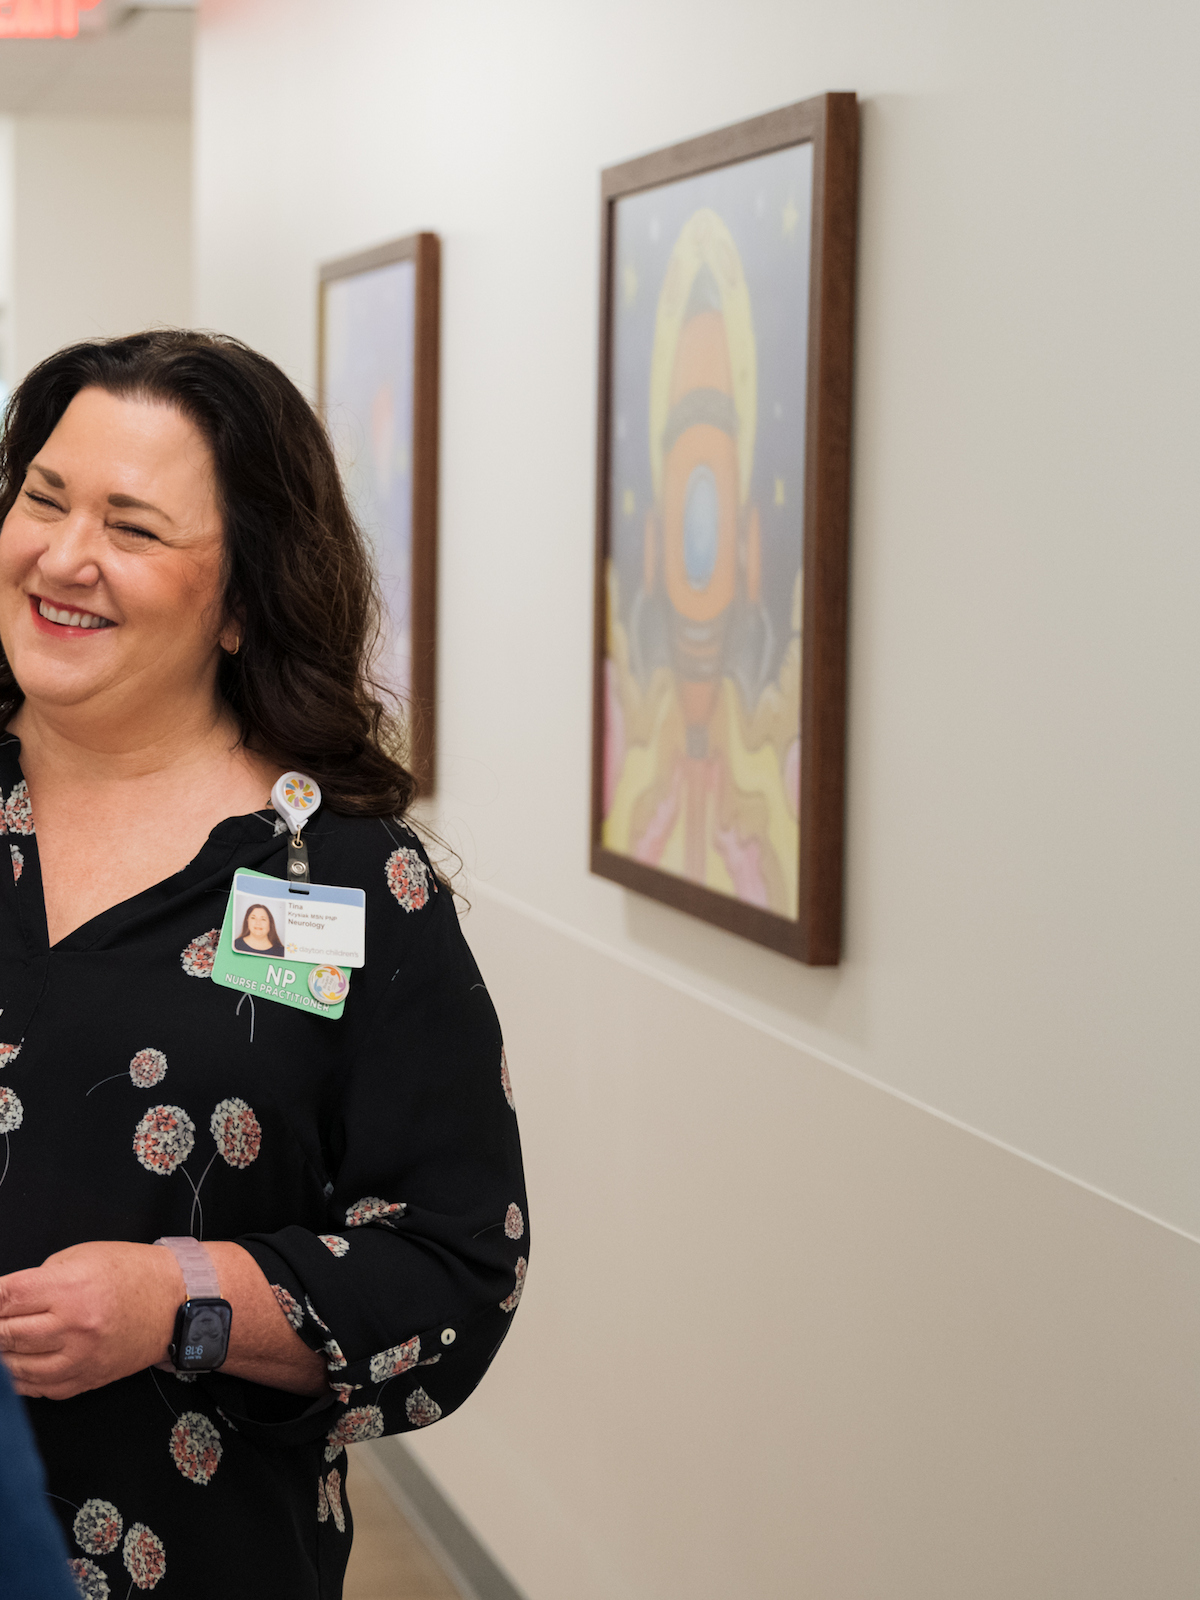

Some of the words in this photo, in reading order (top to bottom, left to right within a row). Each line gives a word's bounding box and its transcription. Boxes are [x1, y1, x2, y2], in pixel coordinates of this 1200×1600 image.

[288, 902, 304, 910] Tina
[288, 918, 326, 930] Neurology
[299, 946, 325, 955] dayton
[325, 949, 359, 958] children's
[265, 964, 296, 988] NP
[225, 973, 258, 990] NURSE
[259, 983, 330, 1012] PRACTITIONER
[185, 1345, 204, 1355] 9:18
